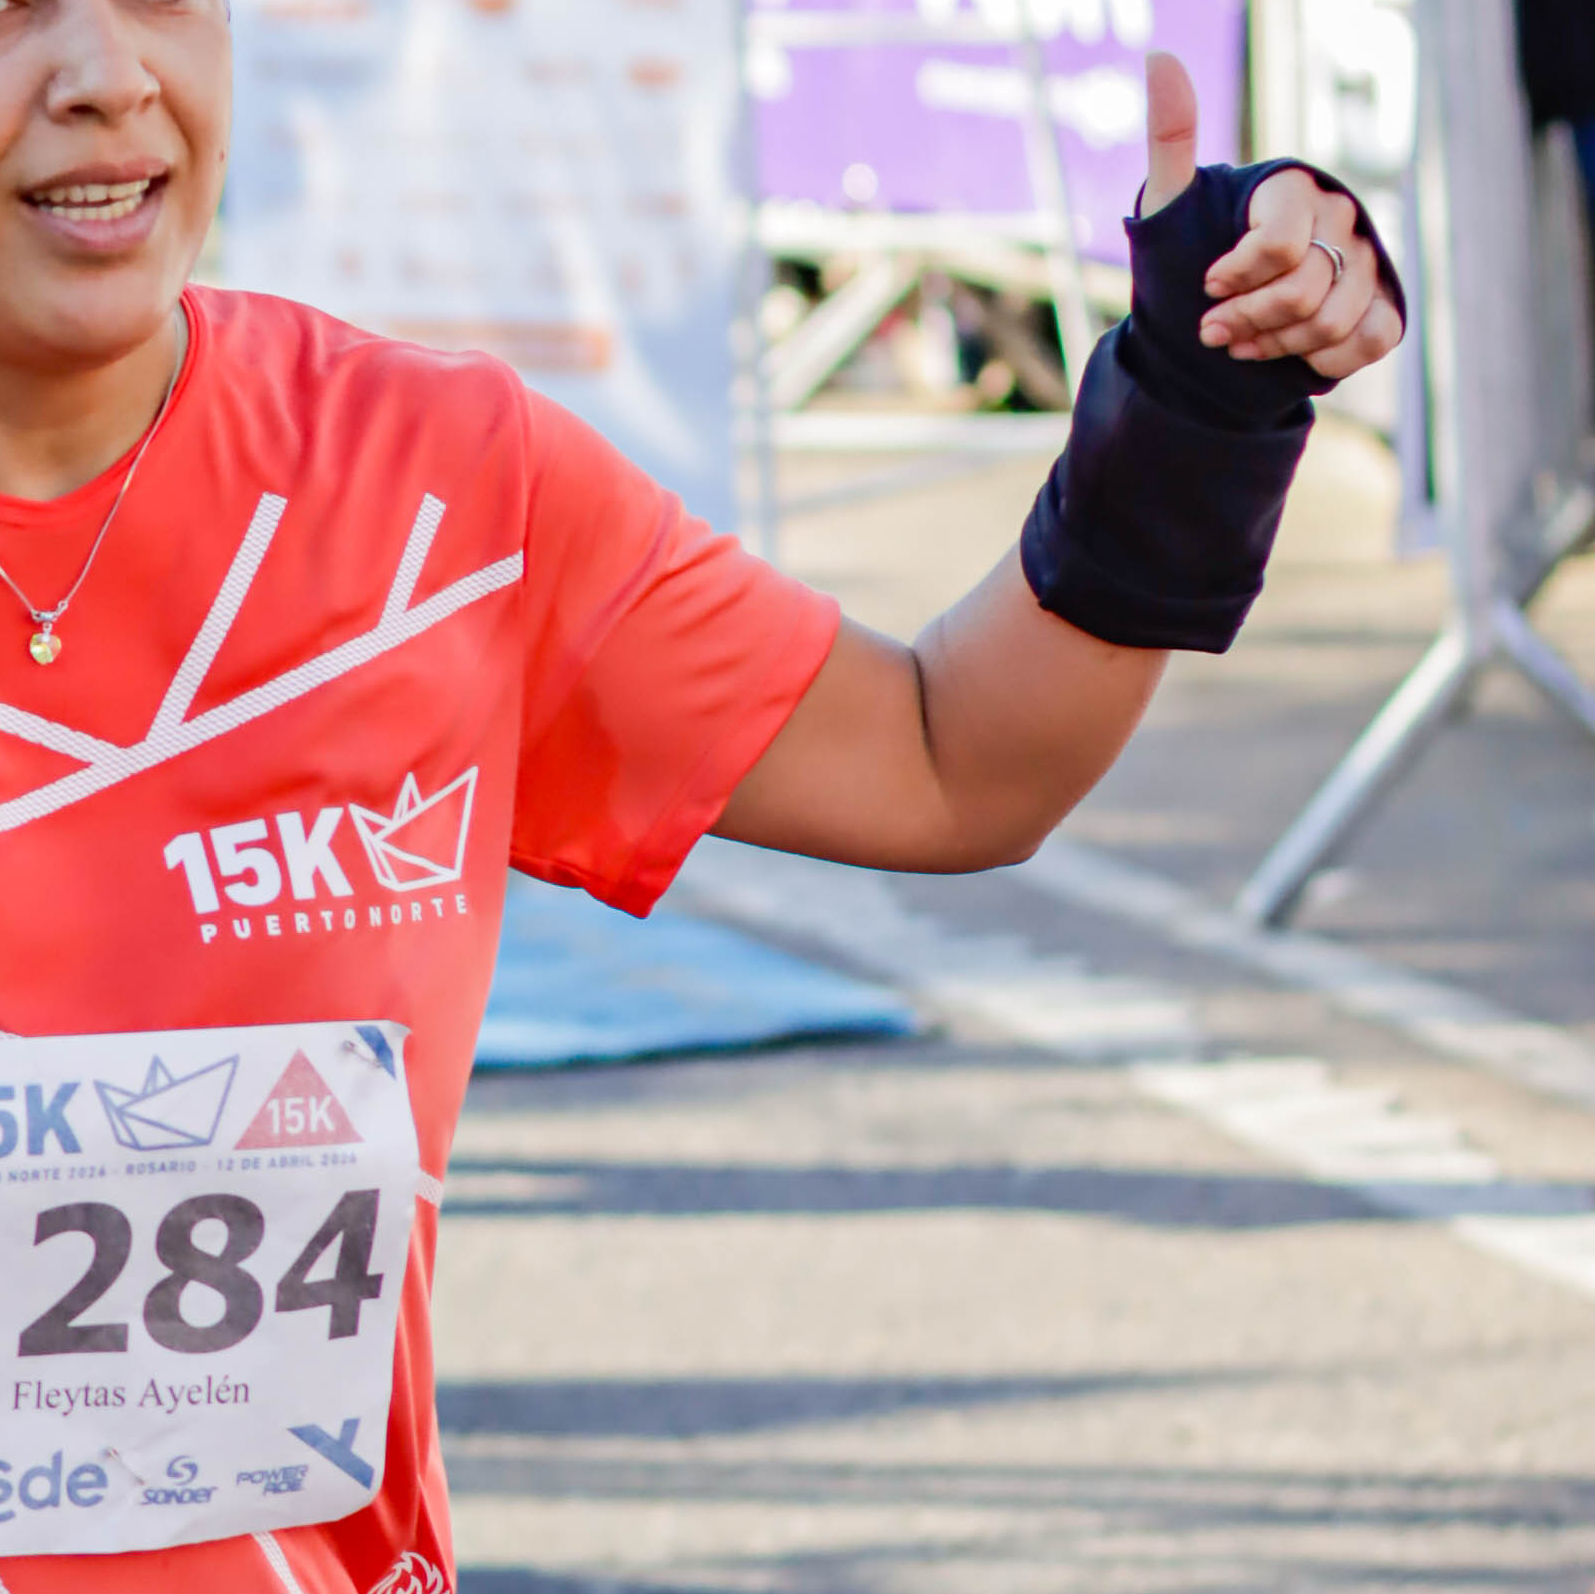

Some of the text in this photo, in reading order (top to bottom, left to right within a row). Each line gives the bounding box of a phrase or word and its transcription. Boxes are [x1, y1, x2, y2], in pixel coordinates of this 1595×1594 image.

[163, 806, 355, 915] 15K
[266, 1095, 336, 1136] 15K
[7, 1167, 61, 1183] NORTE
[125, 1161, 197, 1176] ROSARIO
[217, 1158, 235, 1172] 12
[241, 1157, 261, 1171] DE
[267, 1154, 315, 1169] ABRIL
[11, 1374, 250, 1418] Fleytas Ayelén
[235, 1464, 309, 1486] POWER
